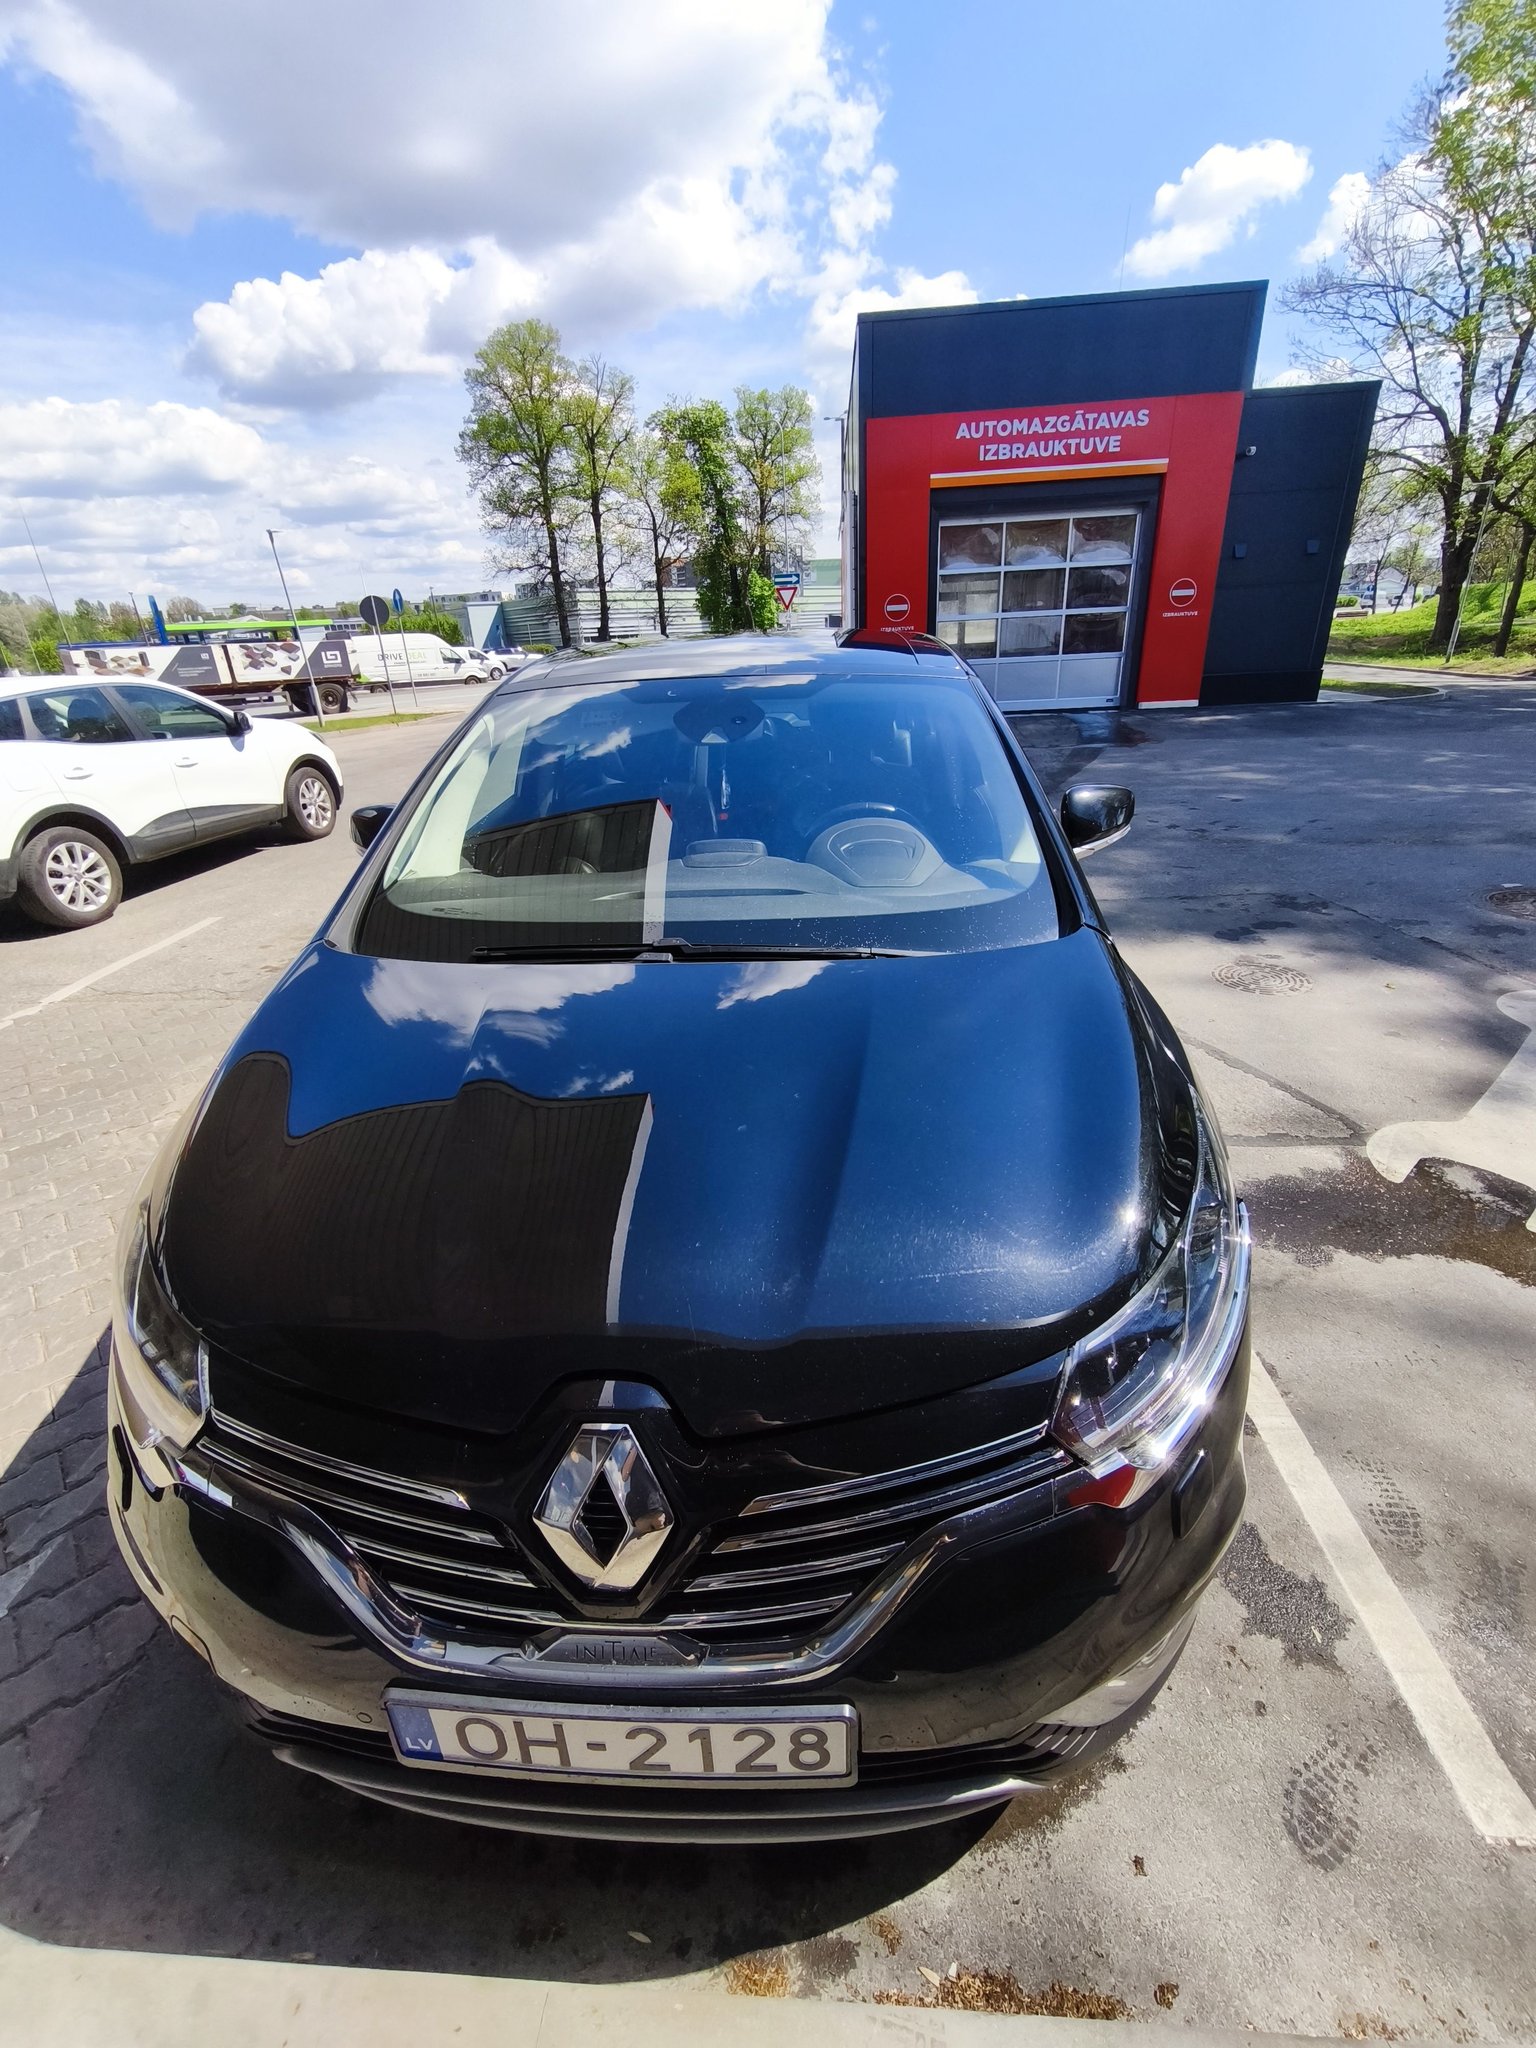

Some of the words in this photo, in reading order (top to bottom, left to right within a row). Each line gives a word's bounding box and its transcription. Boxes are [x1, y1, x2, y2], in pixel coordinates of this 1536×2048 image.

[955, 408, 1150, 440] AUTOMAZGĀTAVAS
[979, 435, 1122, 461] IZBRAUKTUVE
[574, 1640, 656, 1662] INITIALE
[405, 1736, 434, 1754] LV
[455, 1717, 832, 1772] OH-2128
